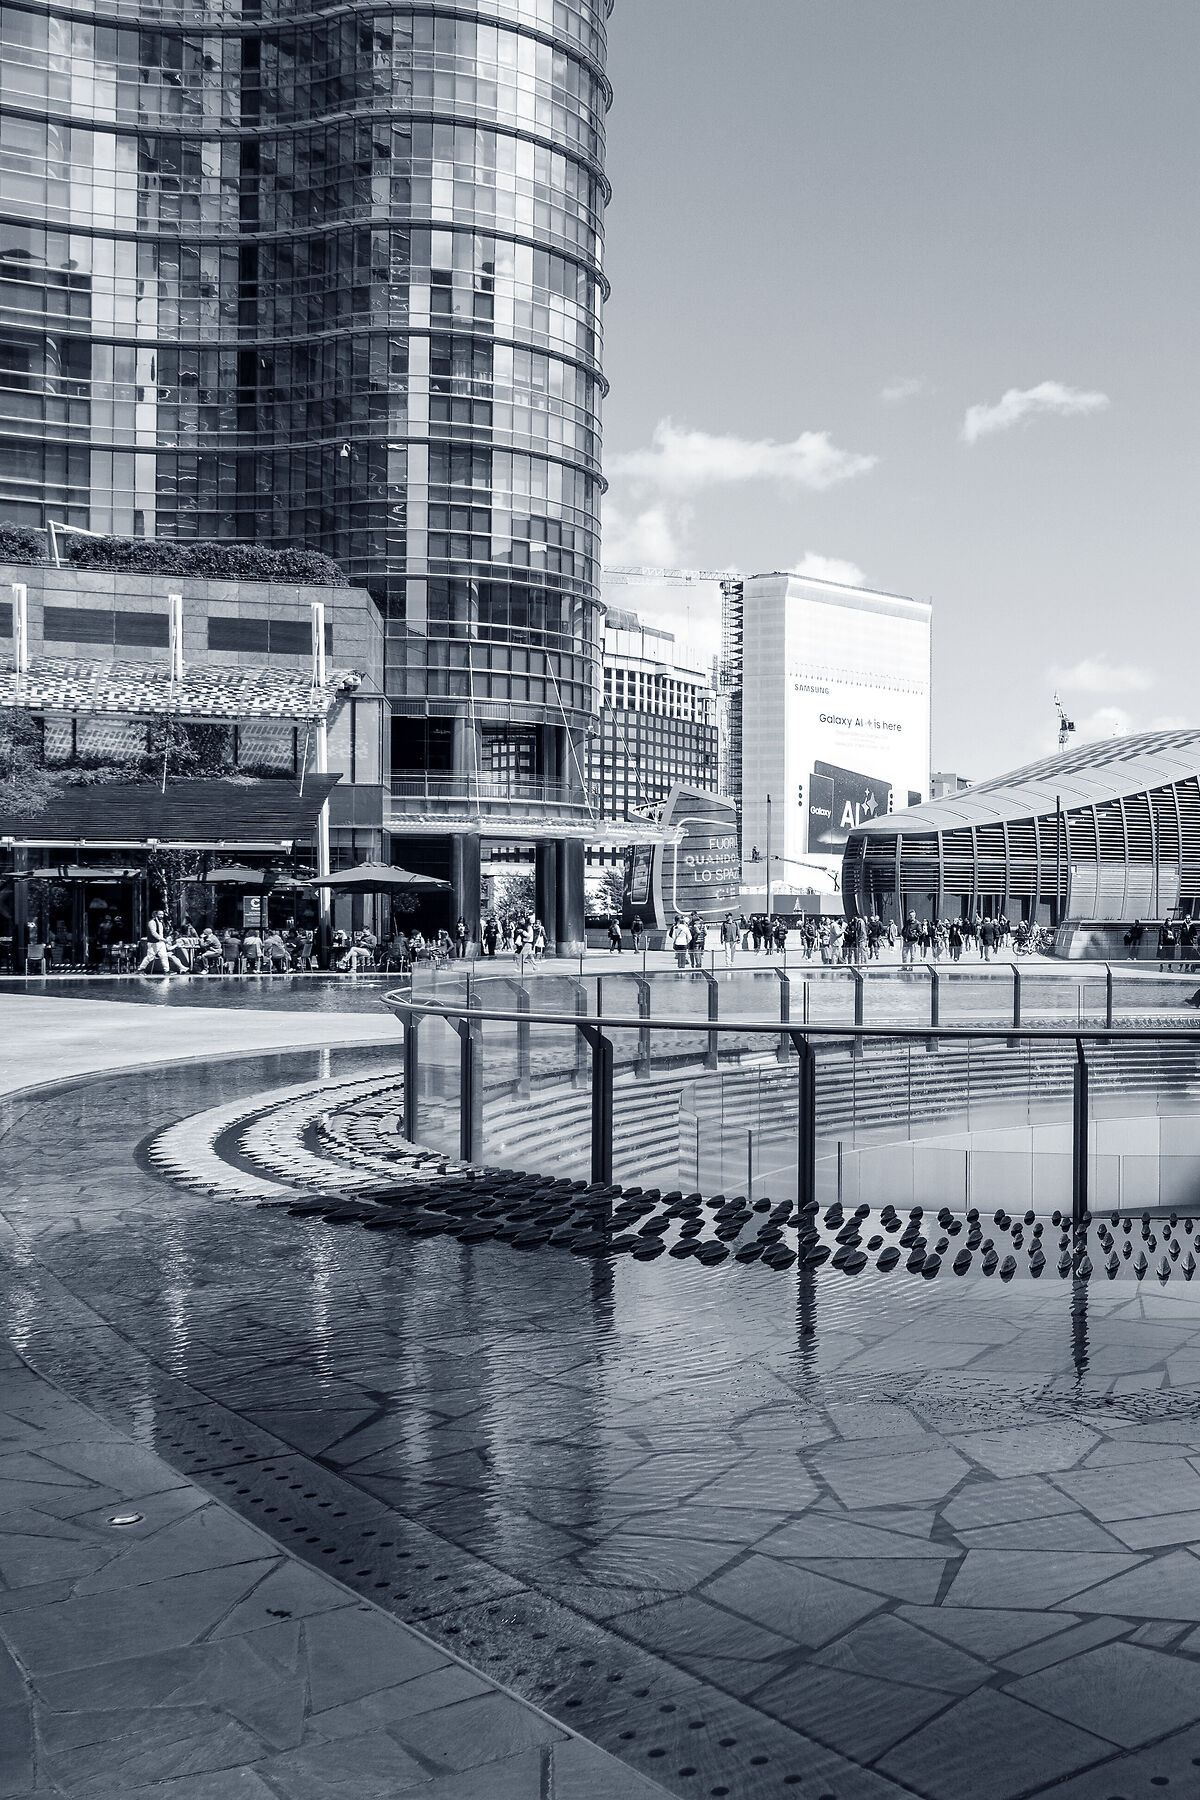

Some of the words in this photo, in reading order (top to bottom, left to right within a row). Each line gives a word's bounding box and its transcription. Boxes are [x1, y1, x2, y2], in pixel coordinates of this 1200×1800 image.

[794, 683, 830, 695] SAMSUNG
[819, 713, 852, 728] Galaxy
[854, 718, 864, 727] AI
[874, 719, 881, 729] is
[882, 721, 902, 732] here
[810, 805, 832, 819] Galaxy
[840, 800, 860, 829] AI
[694, 870, 712, 882] LO
